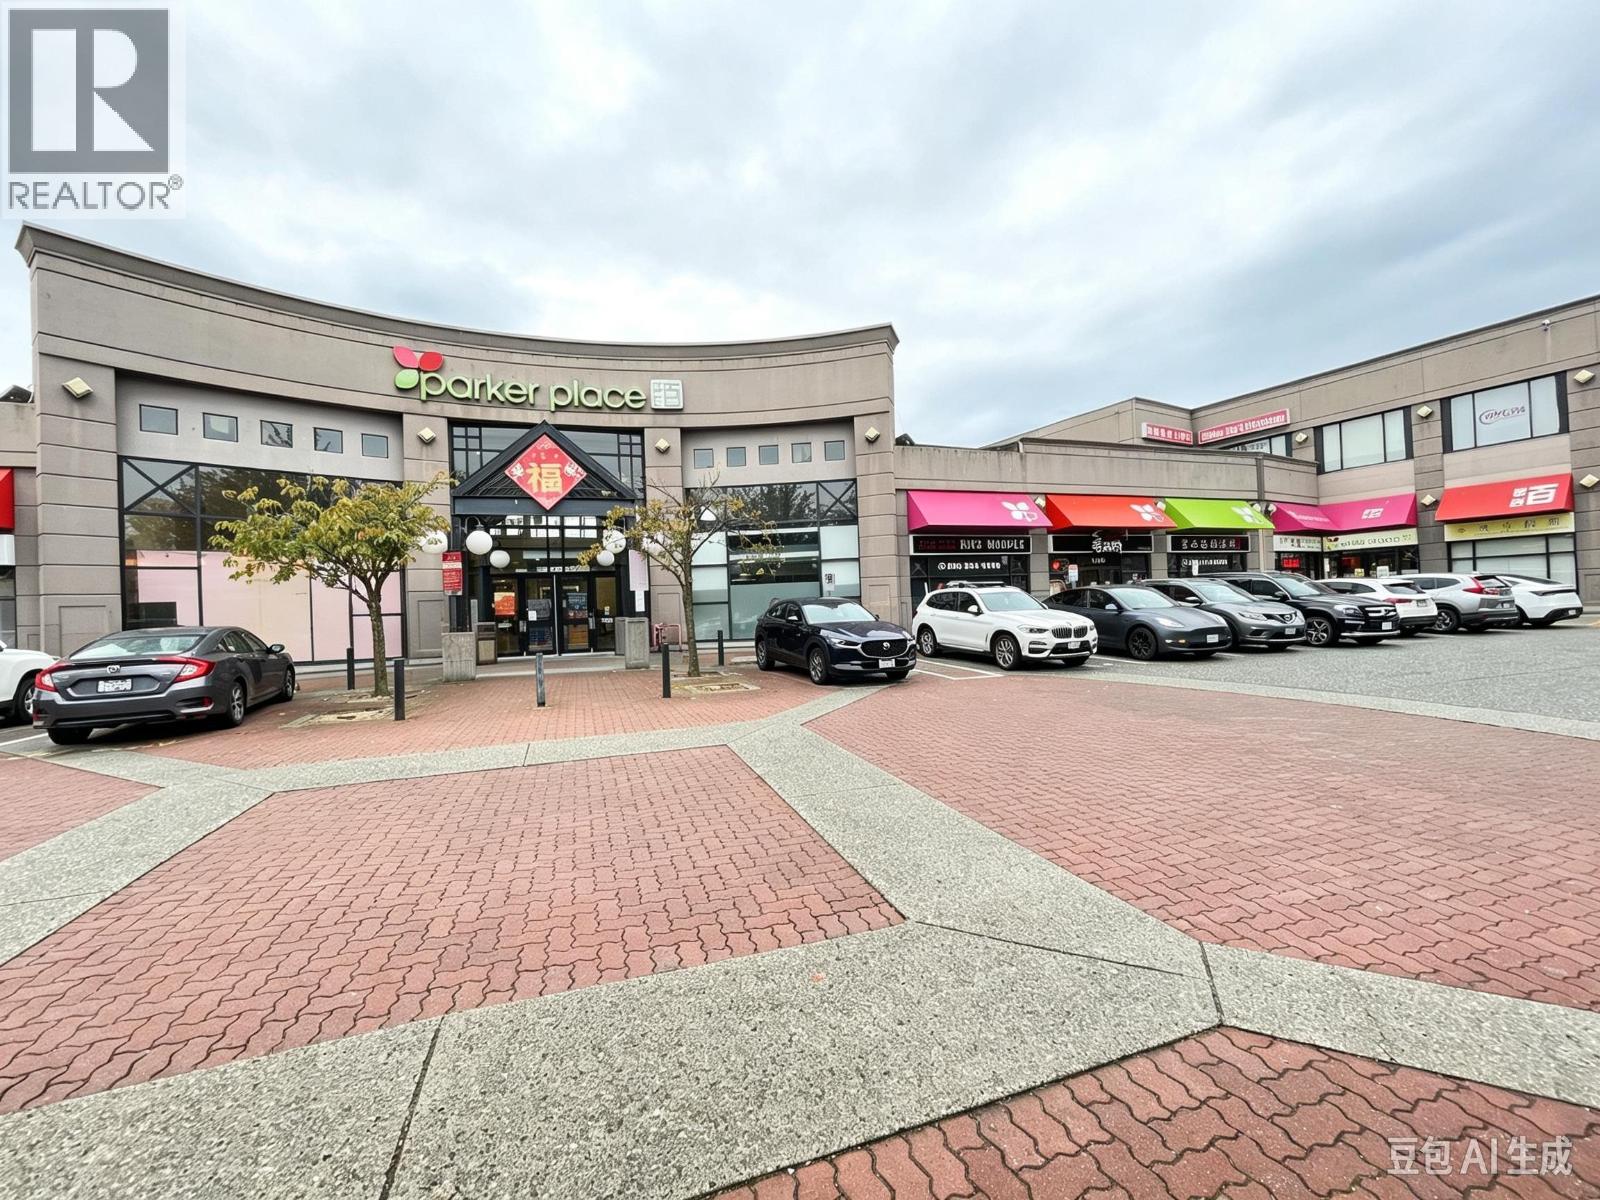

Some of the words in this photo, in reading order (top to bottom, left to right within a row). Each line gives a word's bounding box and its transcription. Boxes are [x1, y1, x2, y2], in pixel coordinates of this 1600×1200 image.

[420, 371, 540, 406] parker
[550, 379, 647, 412] place
[526, 462, 563, 494] 福
